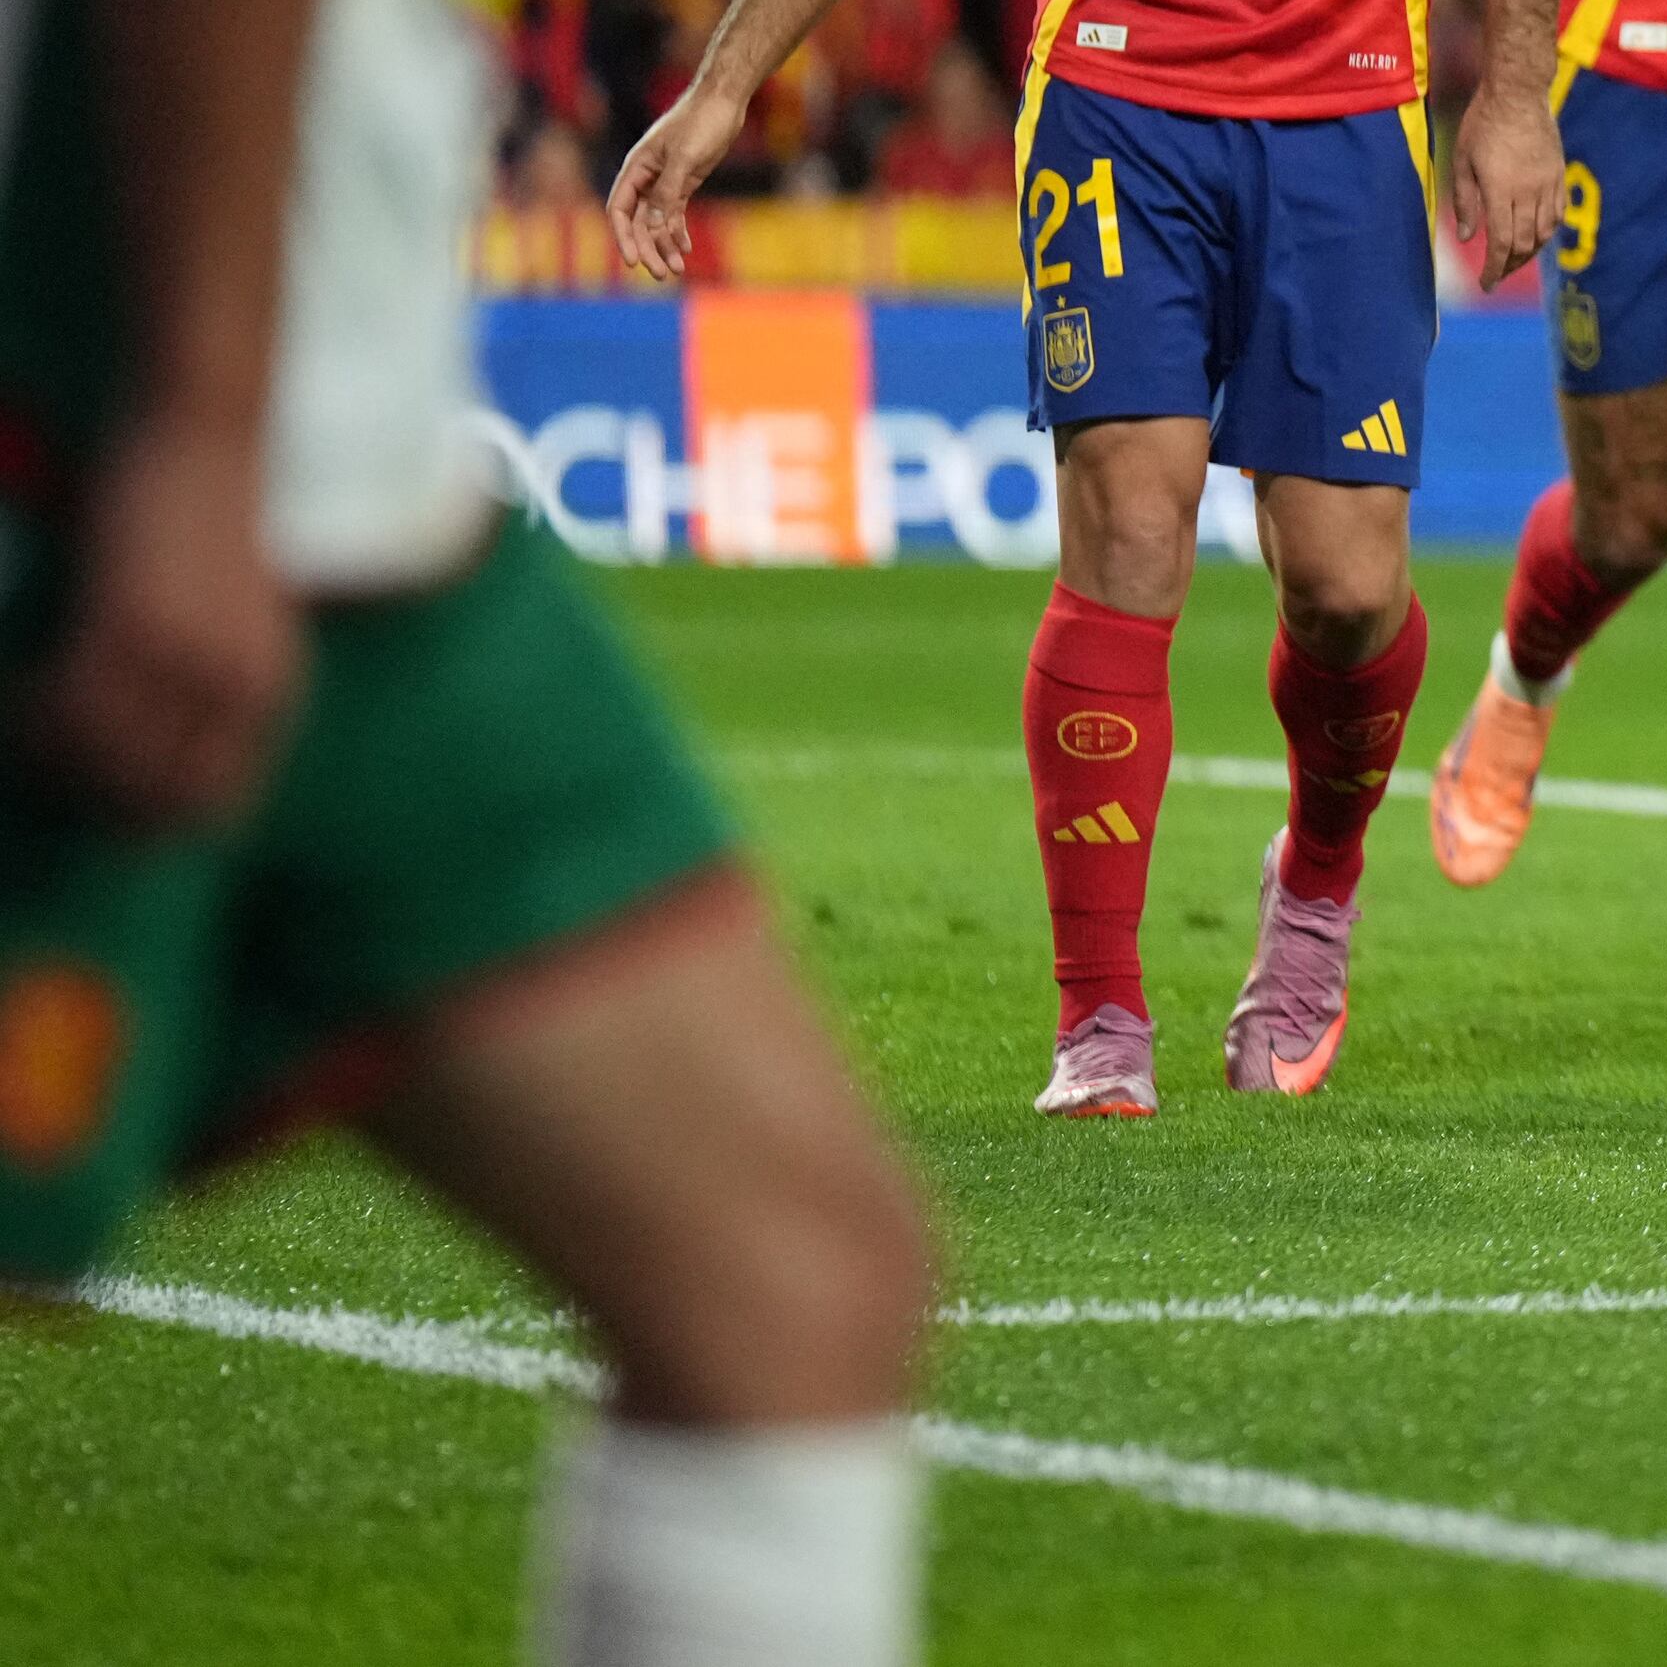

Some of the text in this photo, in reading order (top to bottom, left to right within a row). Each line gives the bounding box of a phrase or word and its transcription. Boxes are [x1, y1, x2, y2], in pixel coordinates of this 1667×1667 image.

[1348, 52, 1398, 71] HEAT.RDY
[1028, 158, 1124, 291] 21
[1556, 161, 1602, 274] 9
